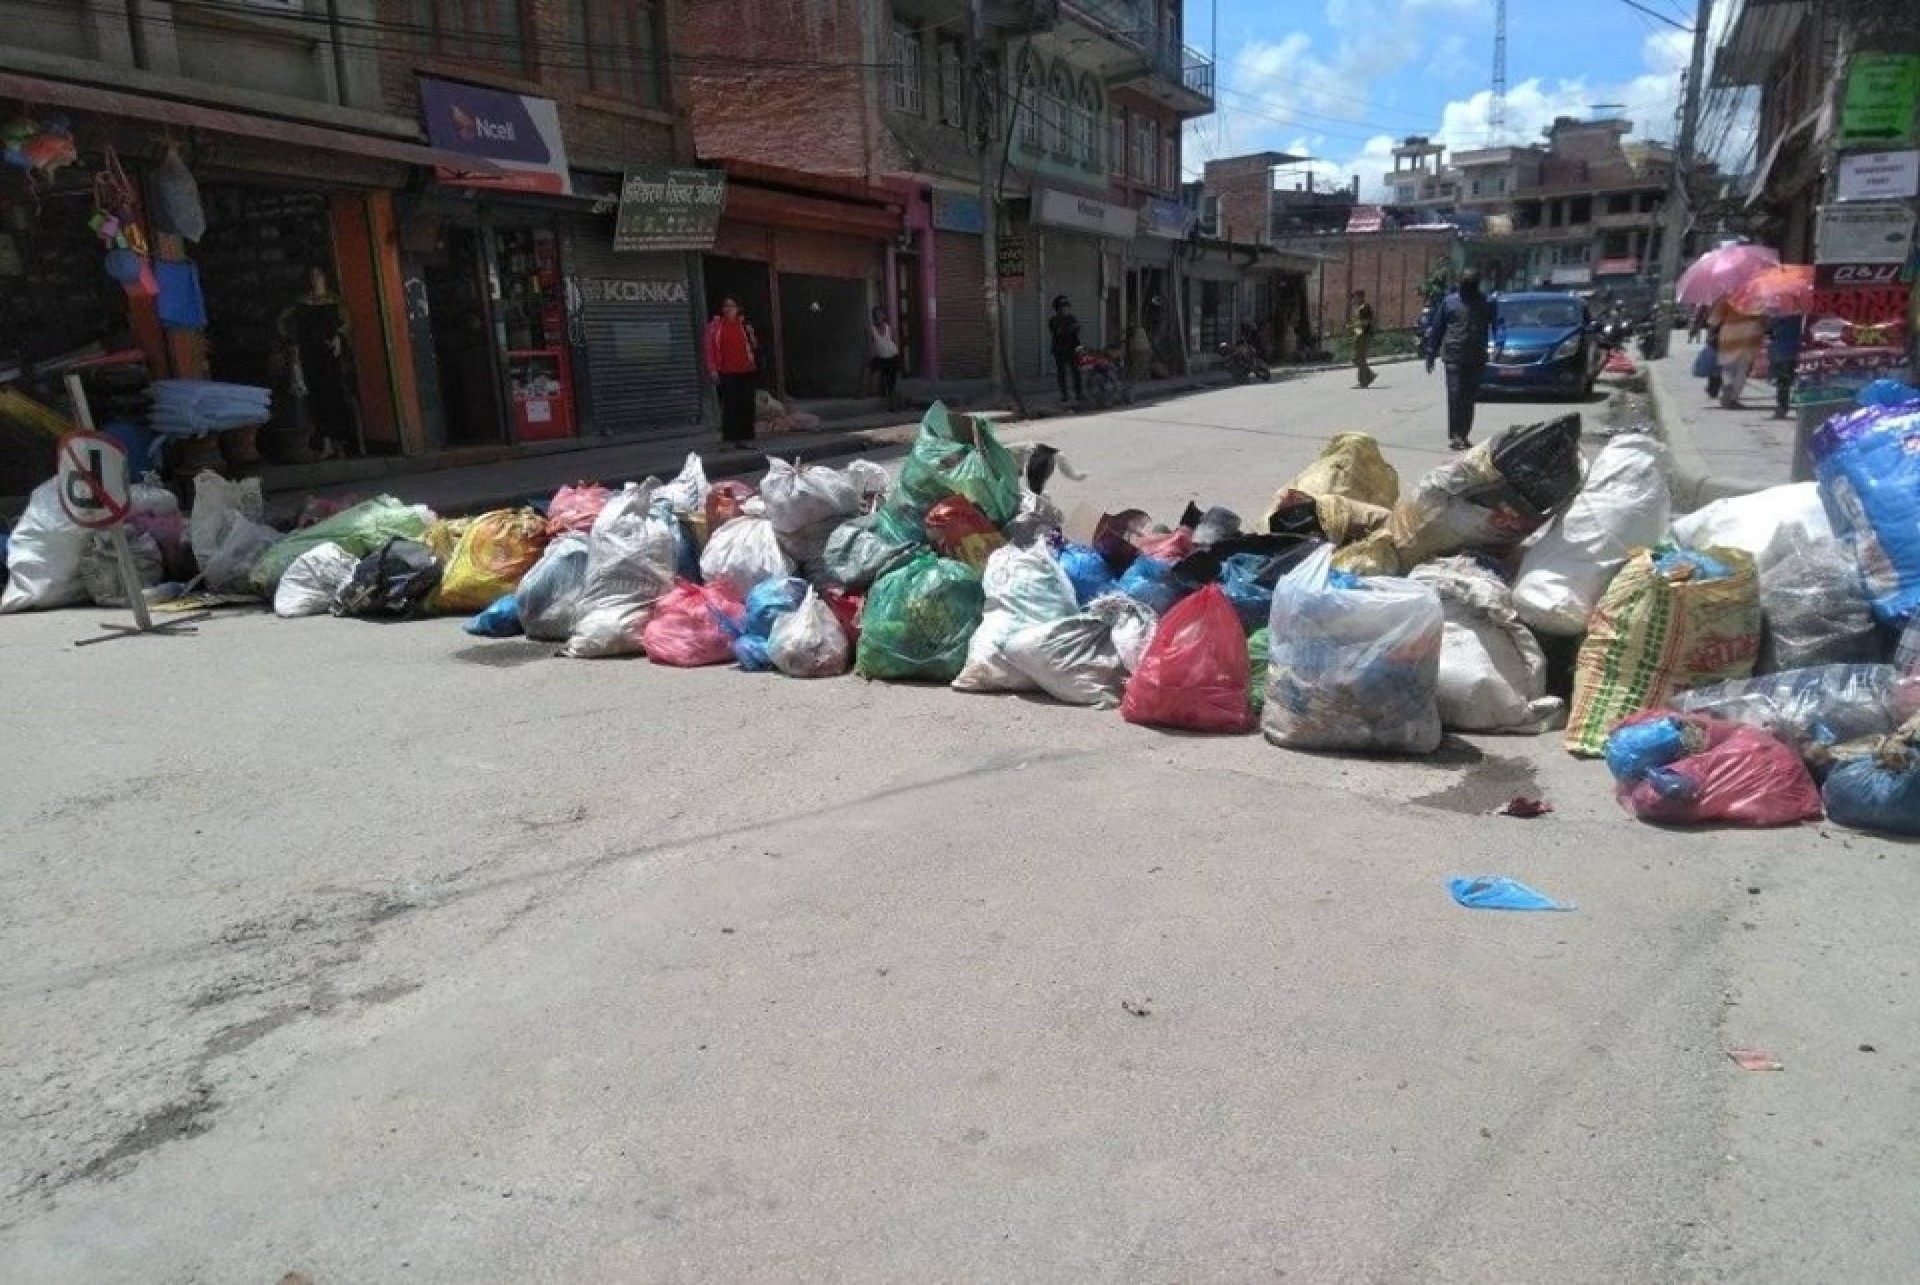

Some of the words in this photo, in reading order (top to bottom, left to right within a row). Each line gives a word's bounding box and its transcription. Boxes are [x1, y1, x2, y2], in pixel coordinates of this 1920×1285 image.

[475, 116, 516, 141] Ncell
[604, 280, 690, 302] KONKA
[1794, 358, 1847, 373] JULY
